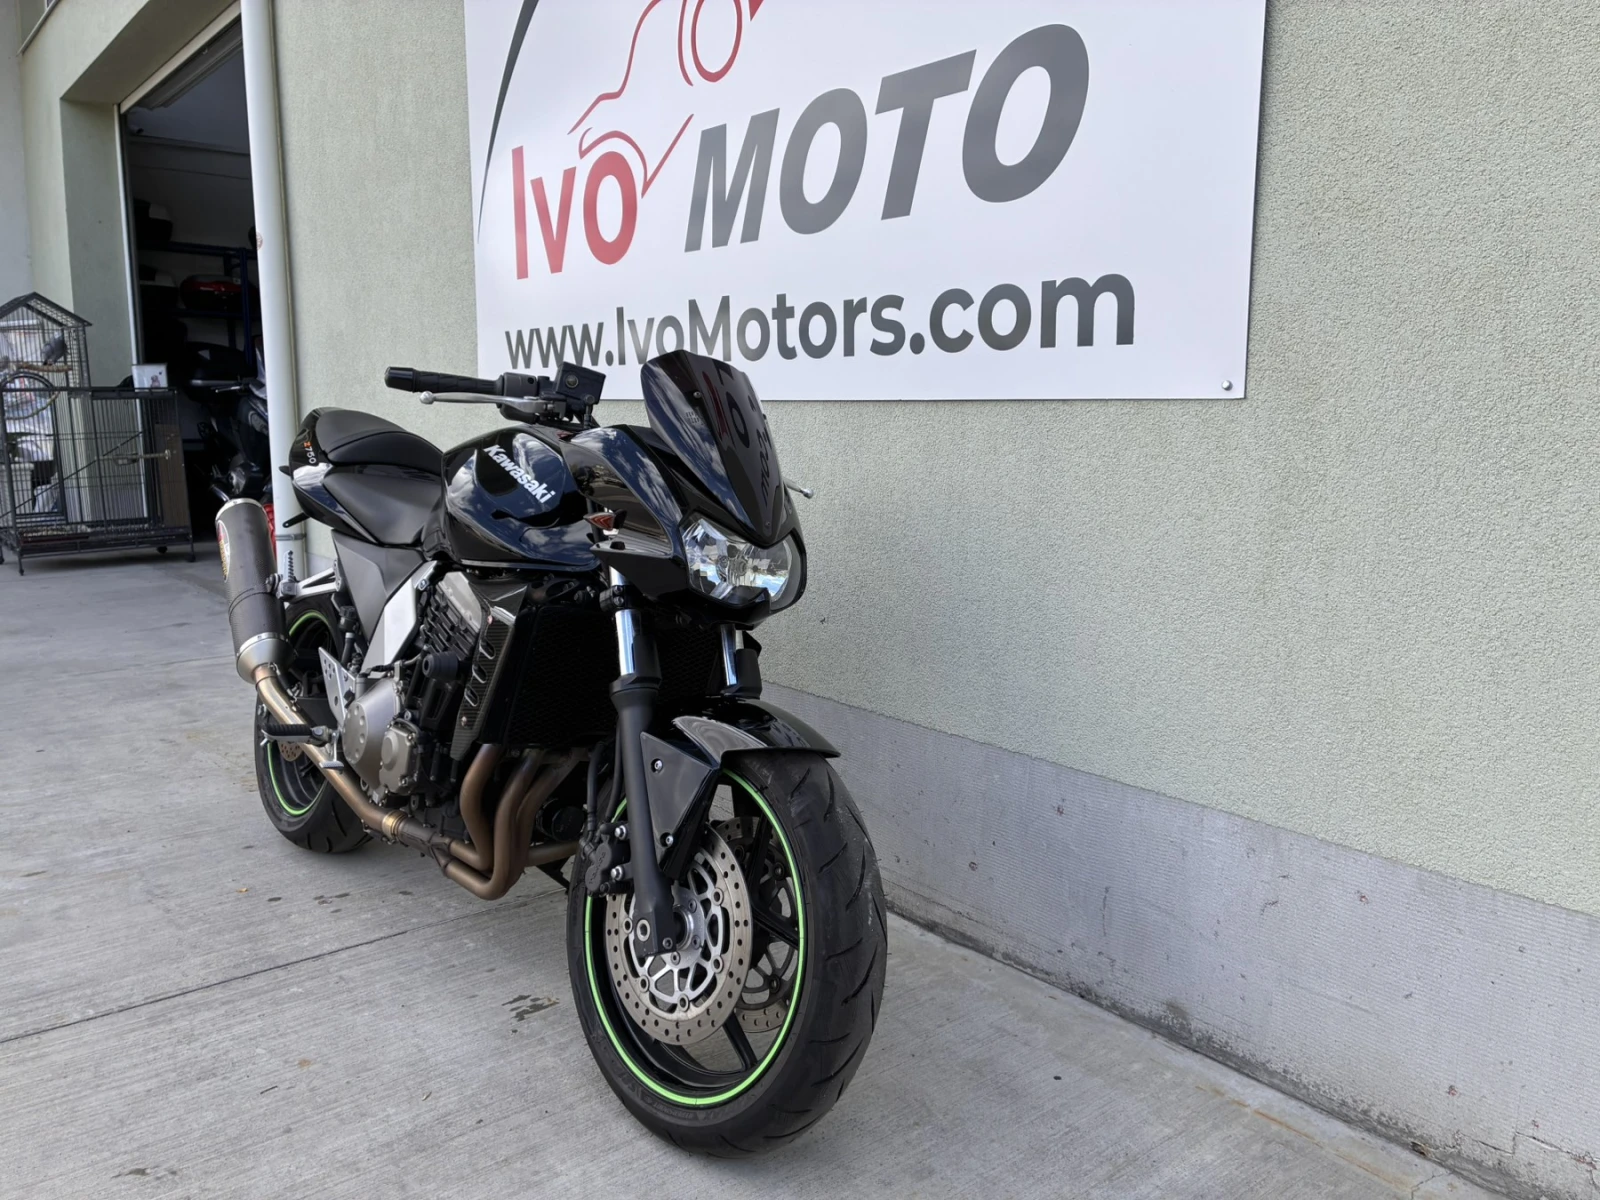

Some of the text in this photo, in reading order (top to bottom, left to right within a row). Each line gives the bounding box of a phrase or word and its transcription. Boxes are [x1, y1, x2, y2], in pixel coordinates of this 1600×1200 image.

[511, 24, 1090, 280] Ivo MOTO
[505, 274, 1136, 370] www.IvoMotors.com
[483, 444, 556, 504] Kawasaki
